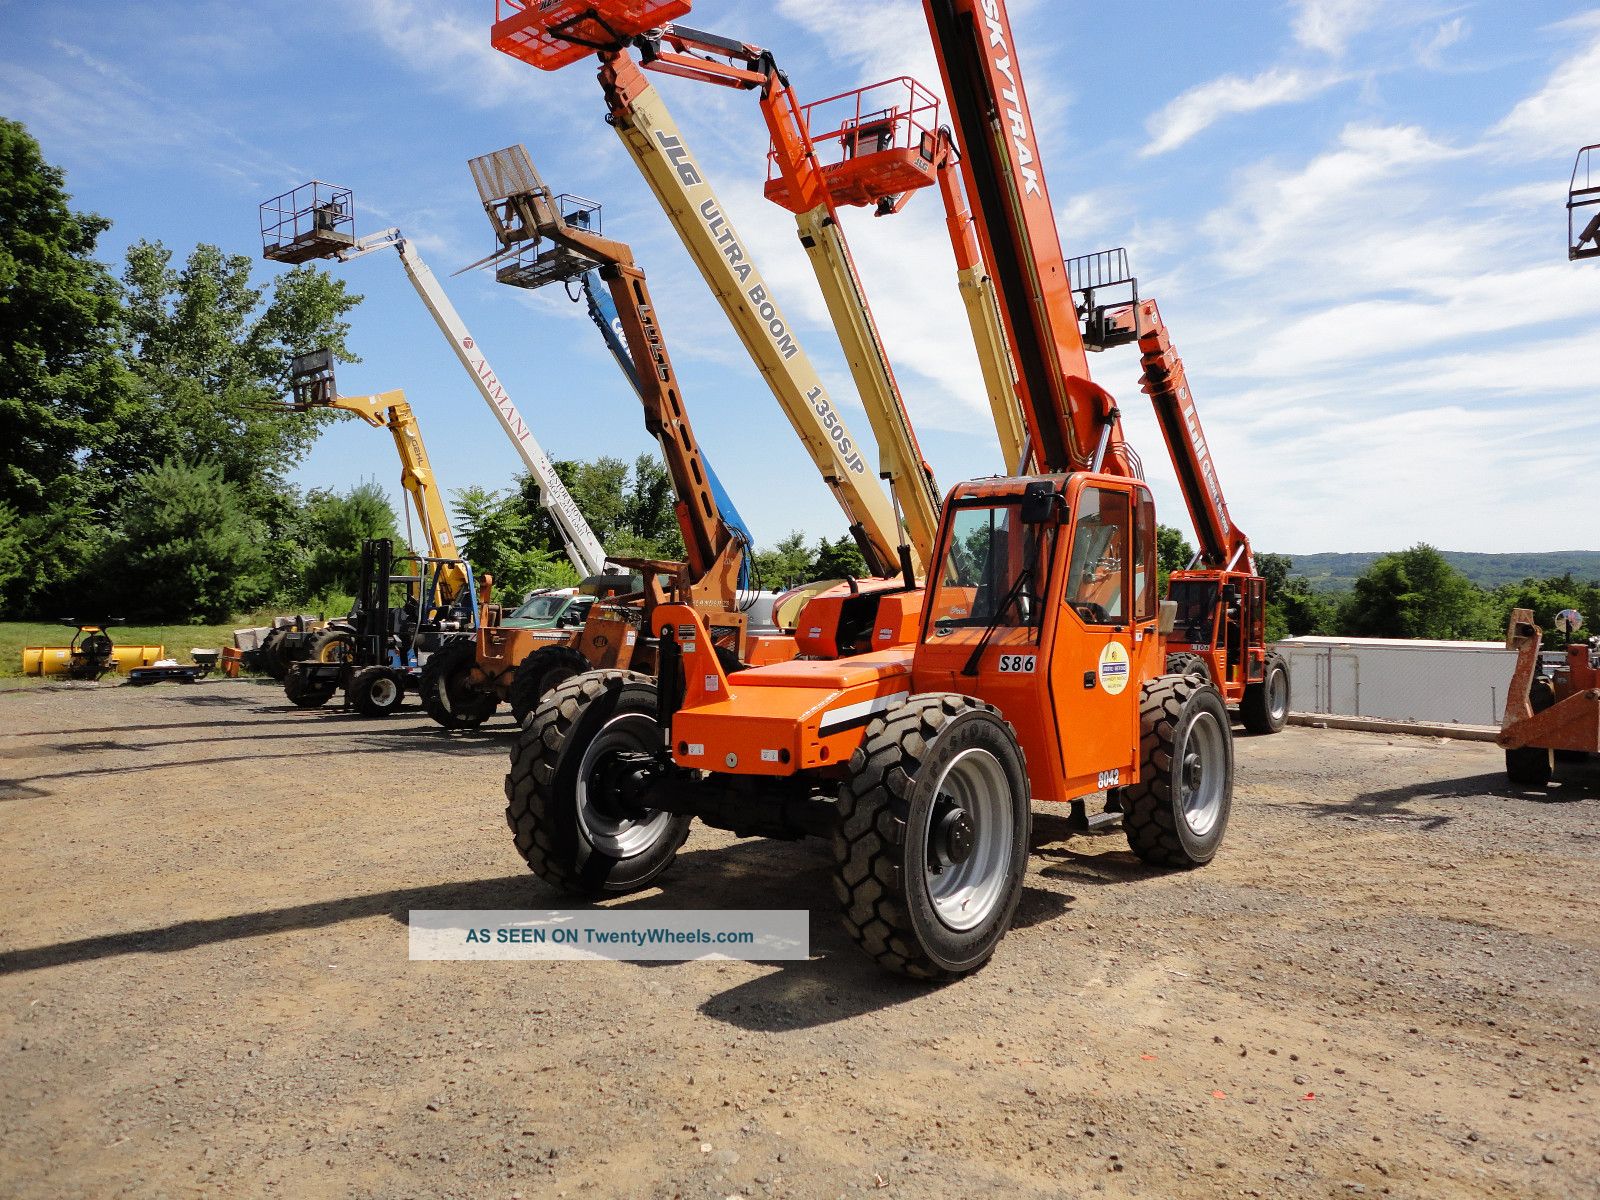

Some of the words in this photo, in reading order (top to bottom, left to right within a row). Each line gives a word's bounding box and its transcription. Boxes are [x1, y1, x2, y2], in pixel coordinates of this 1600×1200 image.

[980, 0, 1042, 198] SKYTRAK
[655, 129, 703, 188] JLG
[700, 198, 752, 284] ULTRA
[747, 283, 799, 361] BOOM
[805, 386, 865, 475] 1350SJP
[470, 360, 530, 441] ARMANI
[411, 440, 424, 467] GEHL
[547, 468, 584, 522] RESTORATION
[581, 523, 592, 537] INC
[1000, 655, 1034, 672] S86
[1097, 768, 1120, 789] 8042
